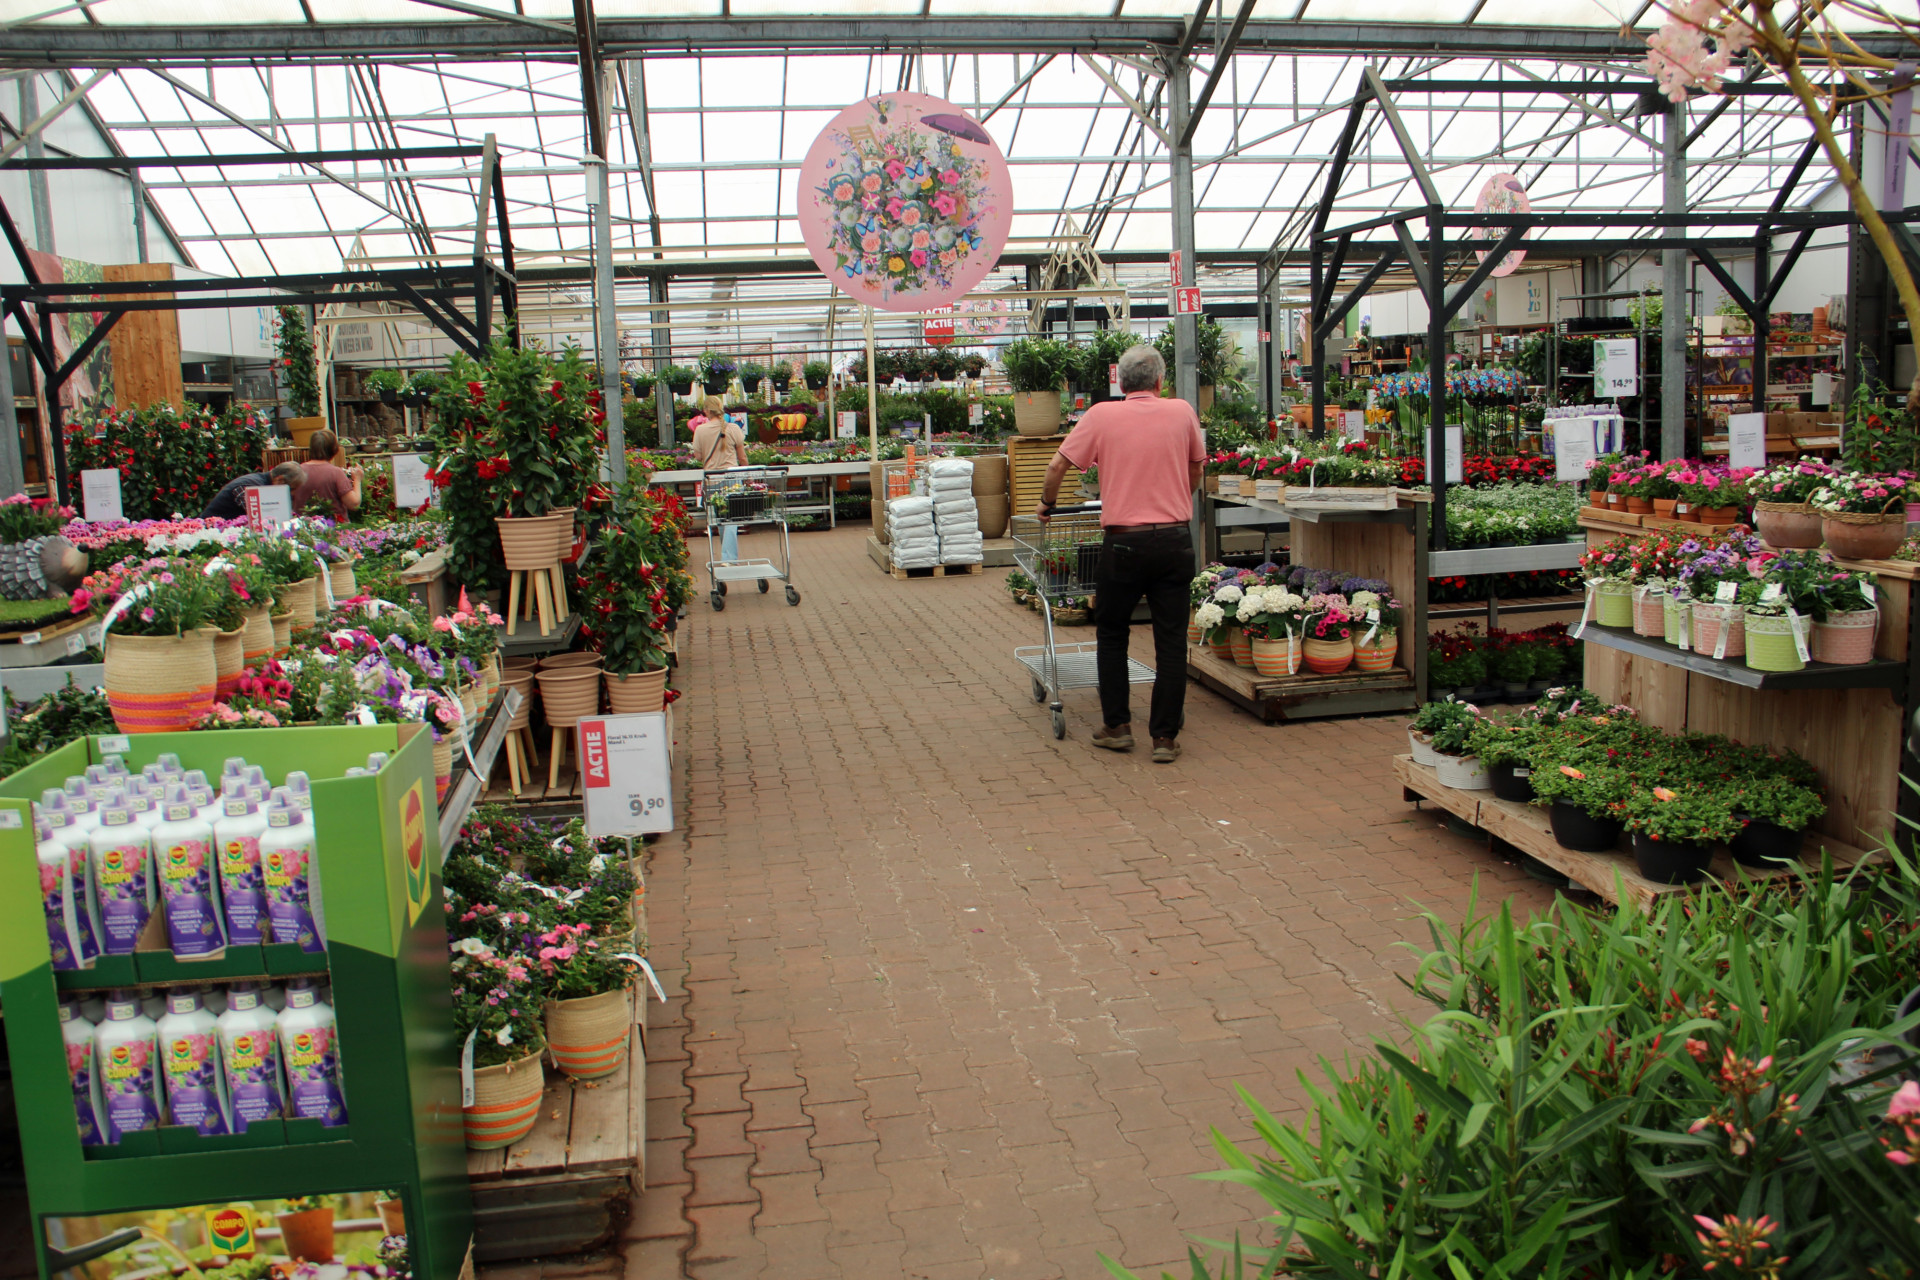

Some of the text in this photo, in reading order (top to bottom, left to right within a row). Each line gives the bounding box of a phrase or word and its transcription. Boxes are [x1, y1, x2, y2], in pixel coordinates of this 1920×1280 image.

[926, 319, 953, 329] ACTIE
[1612, 379, 1632, 388] 14.99
[250, 496, 259, 526] ACTIE
[586, 732, 604, 778] ACTIE
[630, 798, 664, 816] 9.90
[166, 868, 196, 878] COMPO
[224, 863, 250, 874] COMPO
[100, 872, 131, 884] COMPO
[266, 876, 291, 886] COMPO
[232, 1056, 262, 1068] COMPO
[292, 1054, 322, 1066] COMPO
[169, 1061, 199, 1072] COMPO
[107, 1067, 138, 1079] COMPO
[214, 1218, 244, 1229] COMPO
